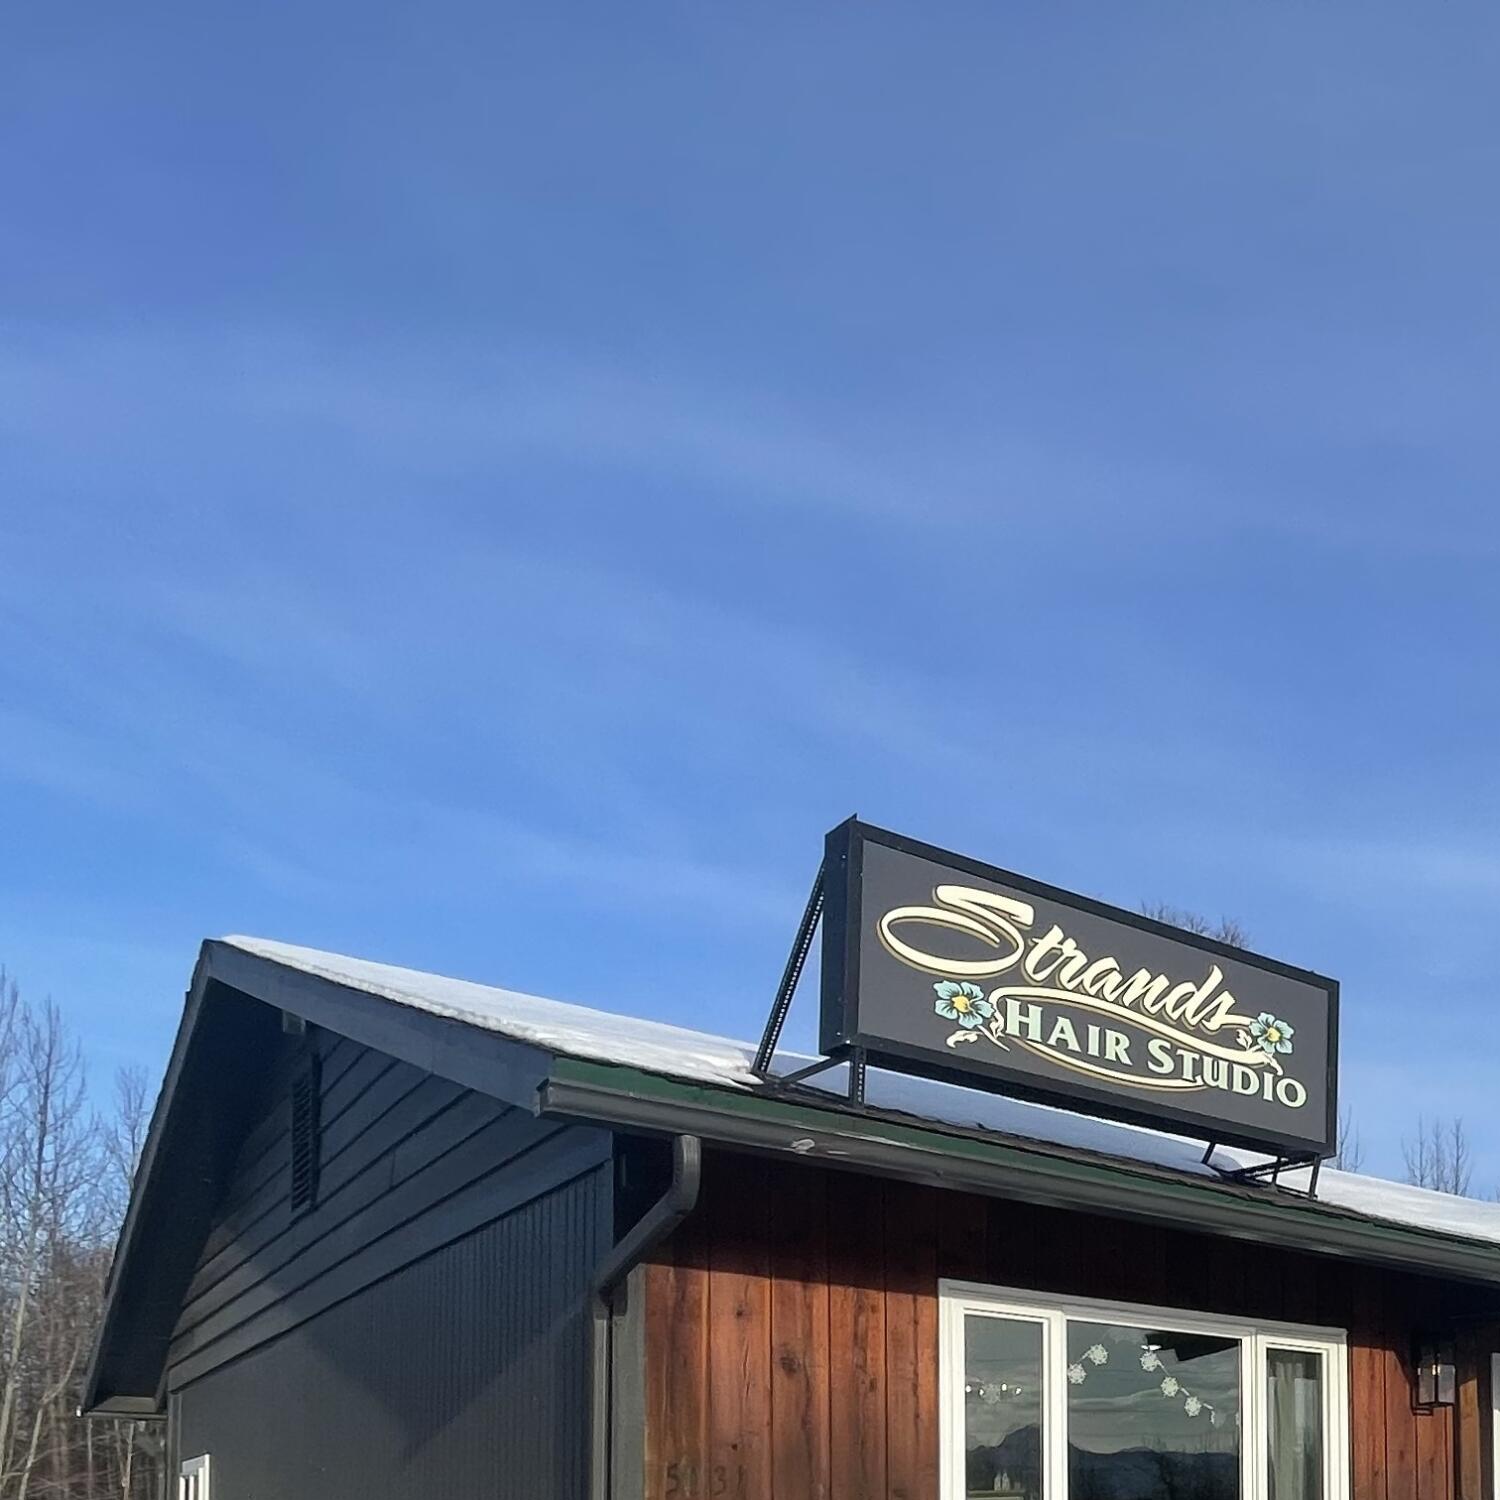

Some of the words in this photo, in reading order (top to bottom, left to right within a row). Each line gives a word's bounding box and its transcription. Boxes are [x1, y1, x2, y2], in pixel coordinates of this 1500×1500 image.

[877, 884, 1254, 1032] Strands
[1004, 997, 1133, 1065] HAIR
[1147, 1038, 1308, 1109] STUDIO
